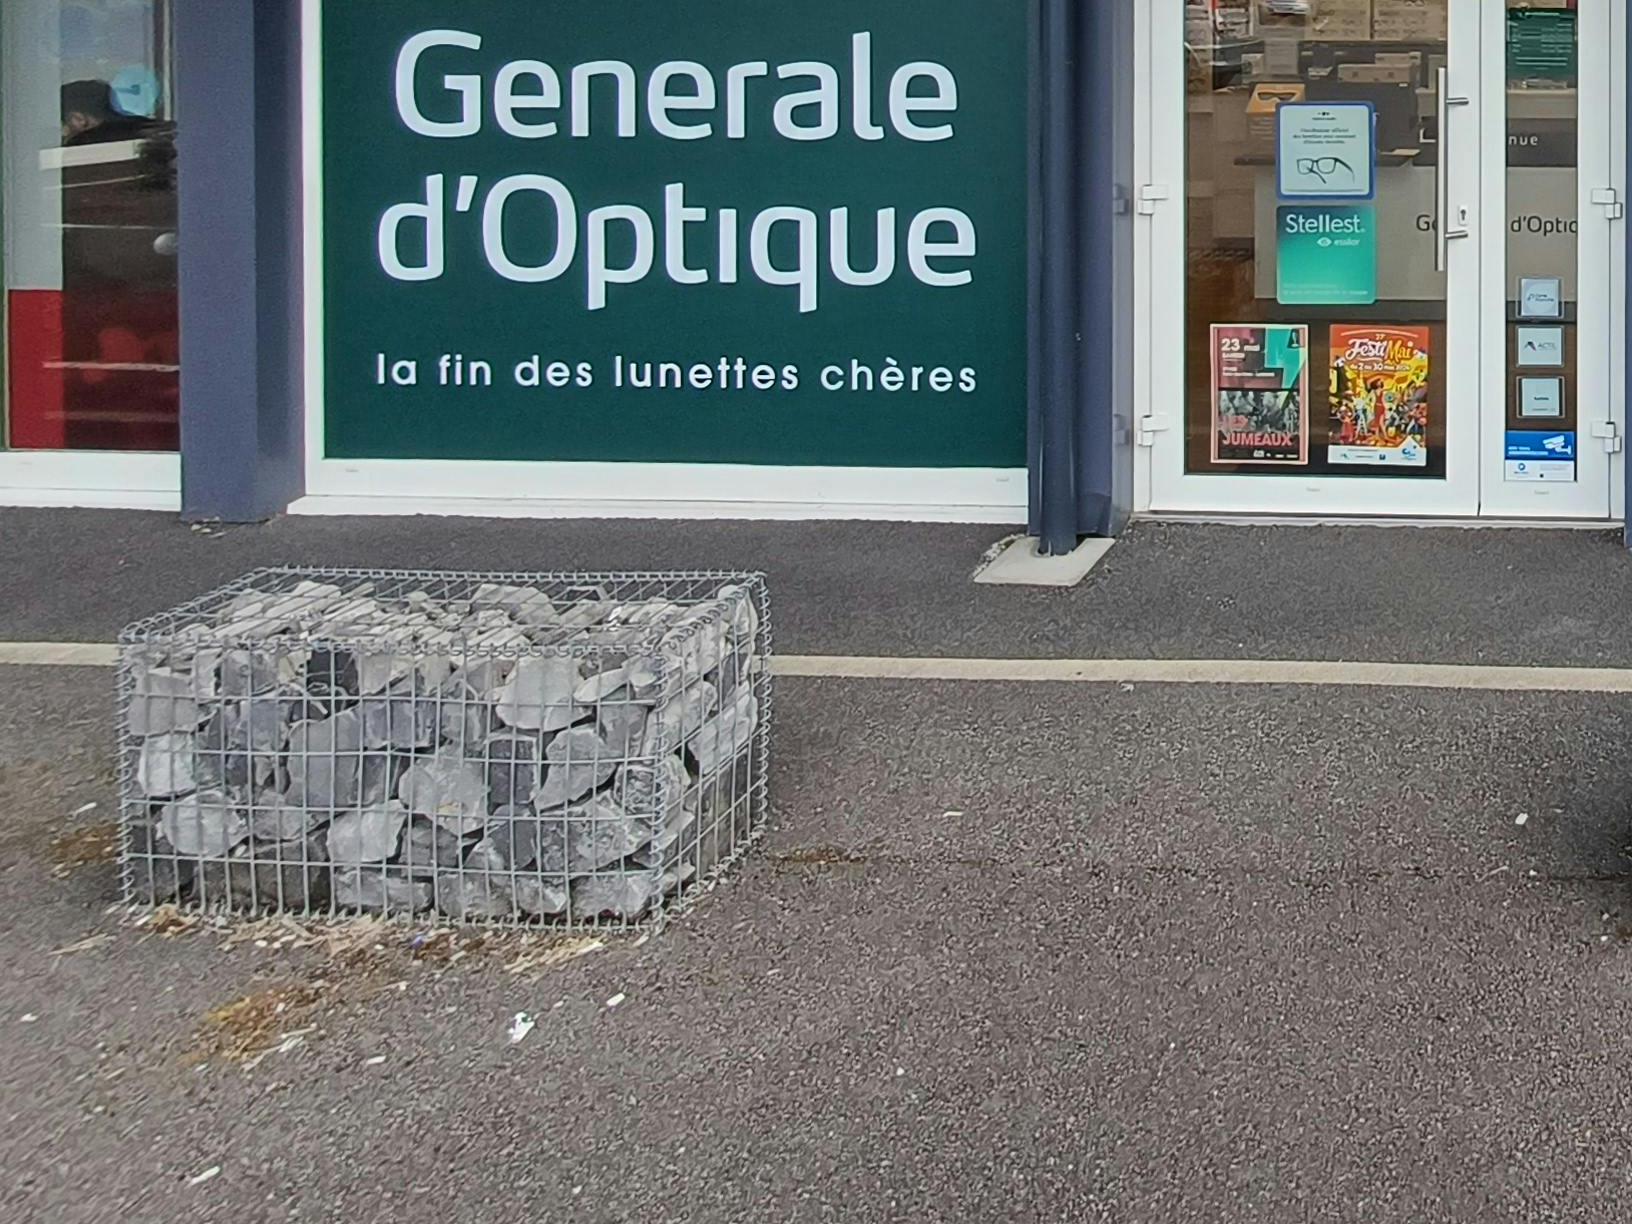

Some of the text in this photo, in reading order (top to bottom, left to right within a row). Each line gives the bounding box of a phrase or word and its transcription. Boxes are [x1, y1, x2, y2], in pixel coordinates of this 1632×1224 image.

[395, 29, 959, 142] Generale
[377, 173, 976, 313] d'Optique
[1285, 214, 1360, 233] Stellest
[377, 353, 976, 392] la fin des lunettes chères
